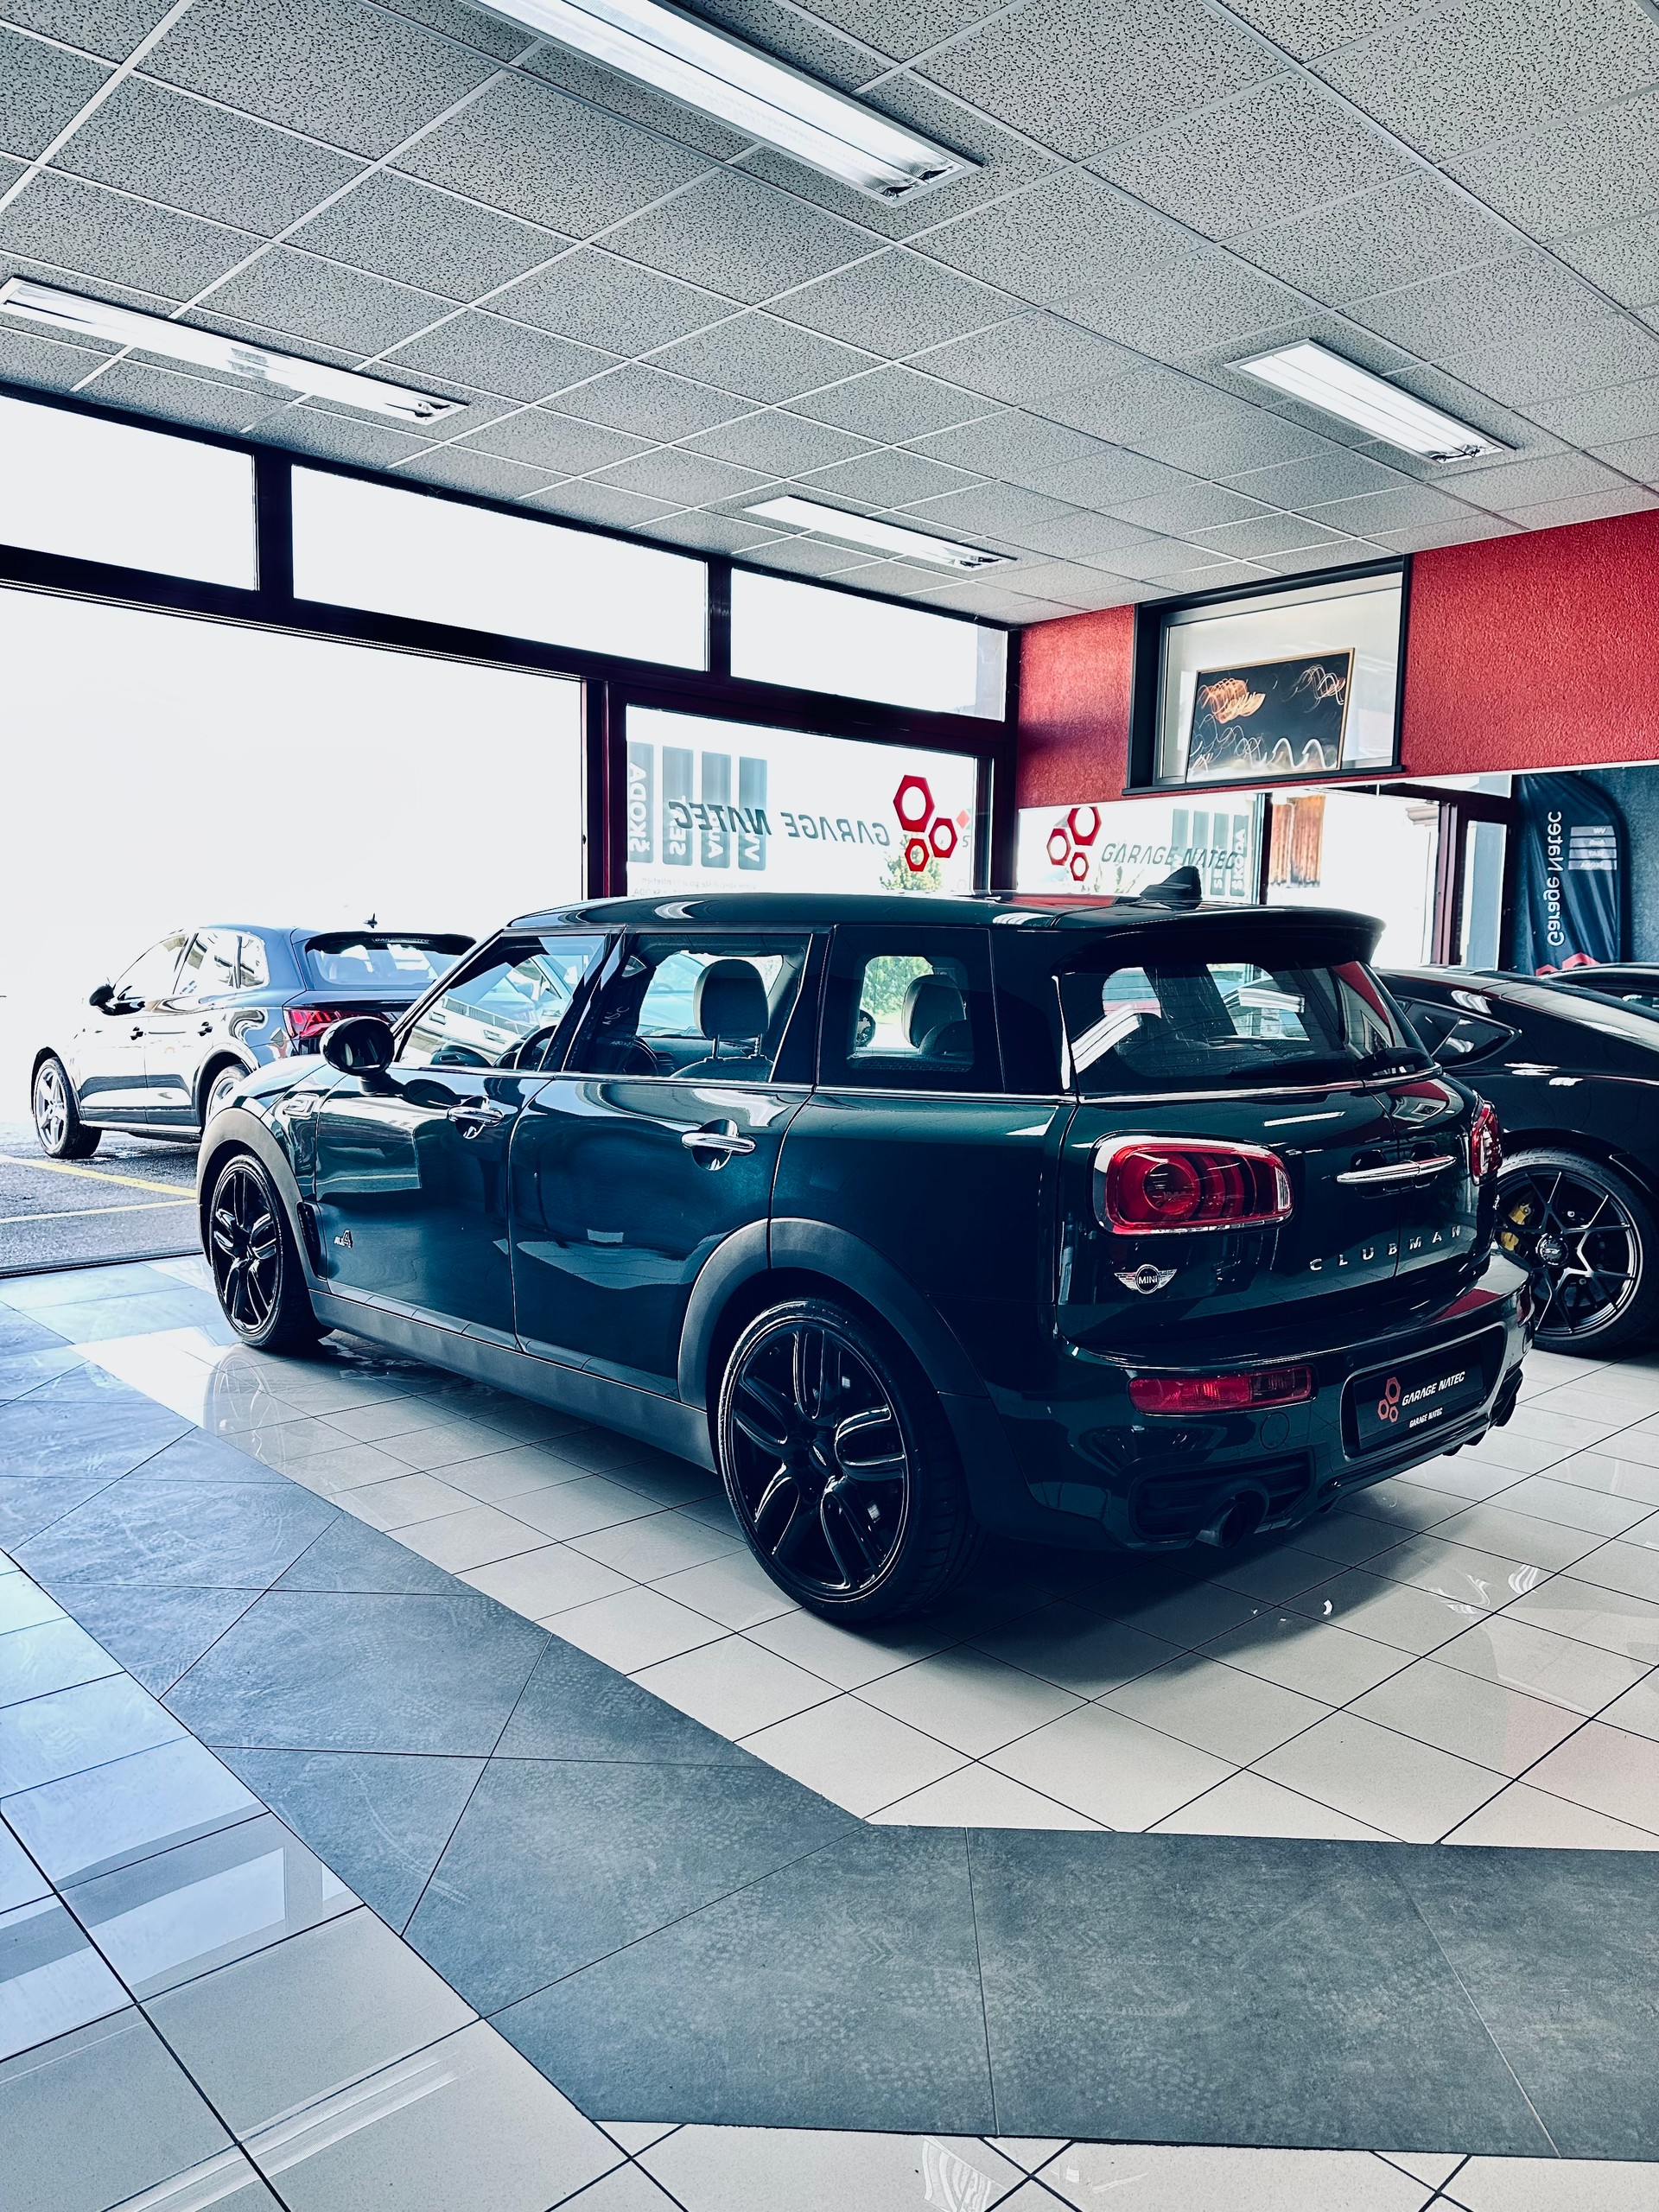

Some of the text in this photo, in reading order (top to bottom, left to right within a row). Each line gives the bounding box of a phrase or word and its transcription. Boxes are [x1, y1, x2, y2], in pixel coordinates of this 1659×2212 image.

[1101, 842, 1179, 866] GARAGE
[1309, 1225, 1462, 1271] CLUBMAN
[1138, 1275, 1158, 1285] MINI
[1402, 1371, 1465, 1407] GARAGE NATEC
